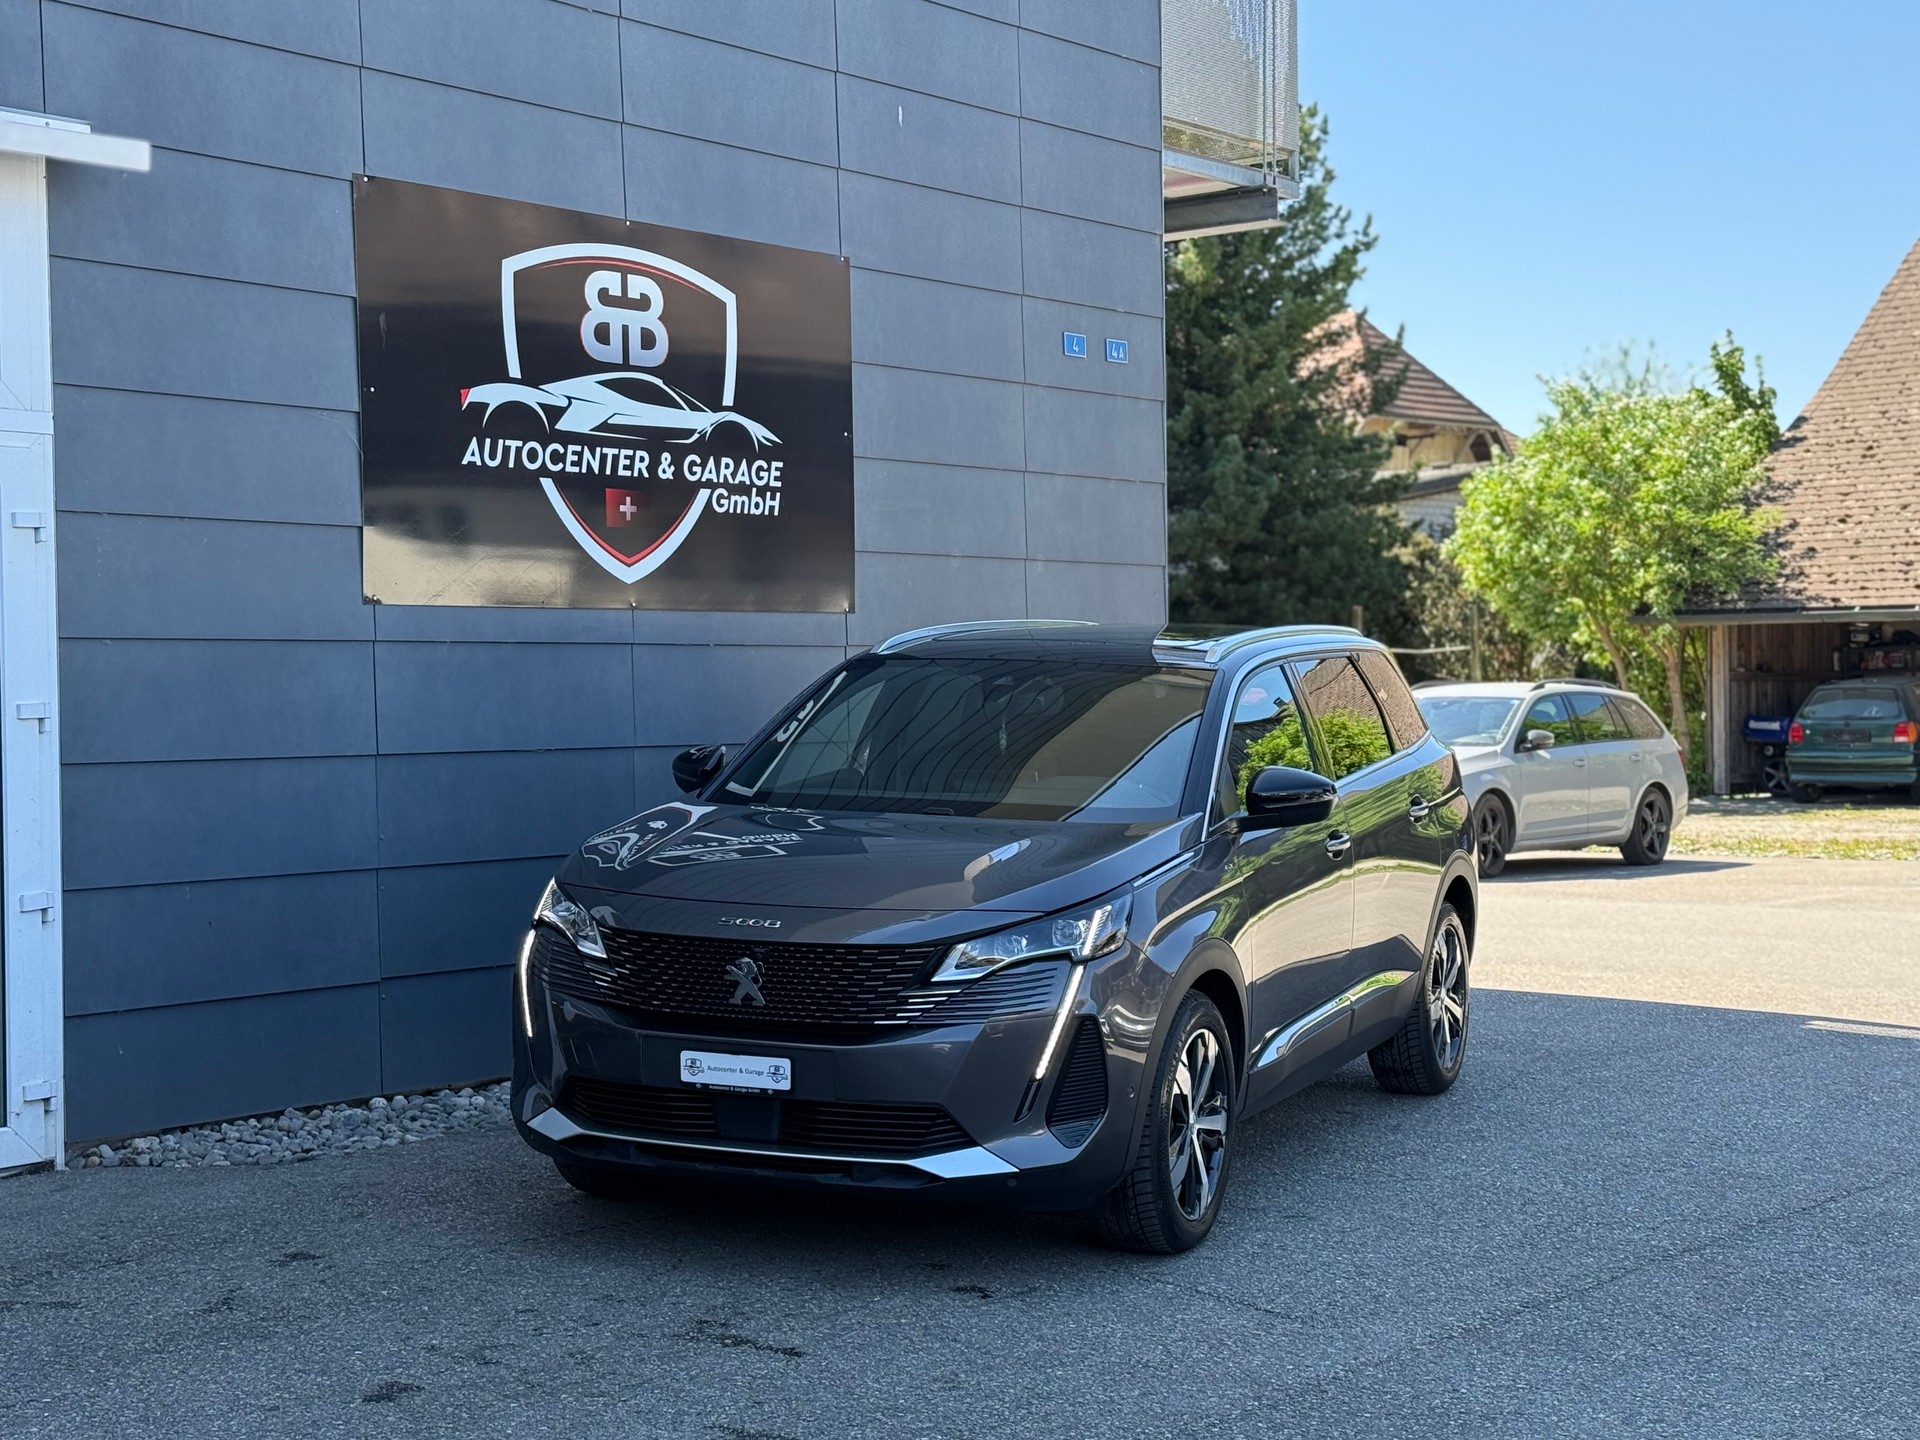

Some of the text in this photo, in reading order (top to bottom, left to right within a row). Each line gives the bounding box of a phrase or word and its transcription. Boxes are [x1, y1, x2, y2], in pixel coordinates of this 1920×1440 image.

[1072, 336, 1079, 353] 4
[1111, 343, 1124, 359] 4A
[461, 436, 784, 488] AUTOCENTER & GARAGE
[711, 487, 781, 516] GmbH
[717, 917, 781, 928] 5008
[707, 1065, 738, 1073] Autocenter
[745, 1068, 765, 1076] Garage
